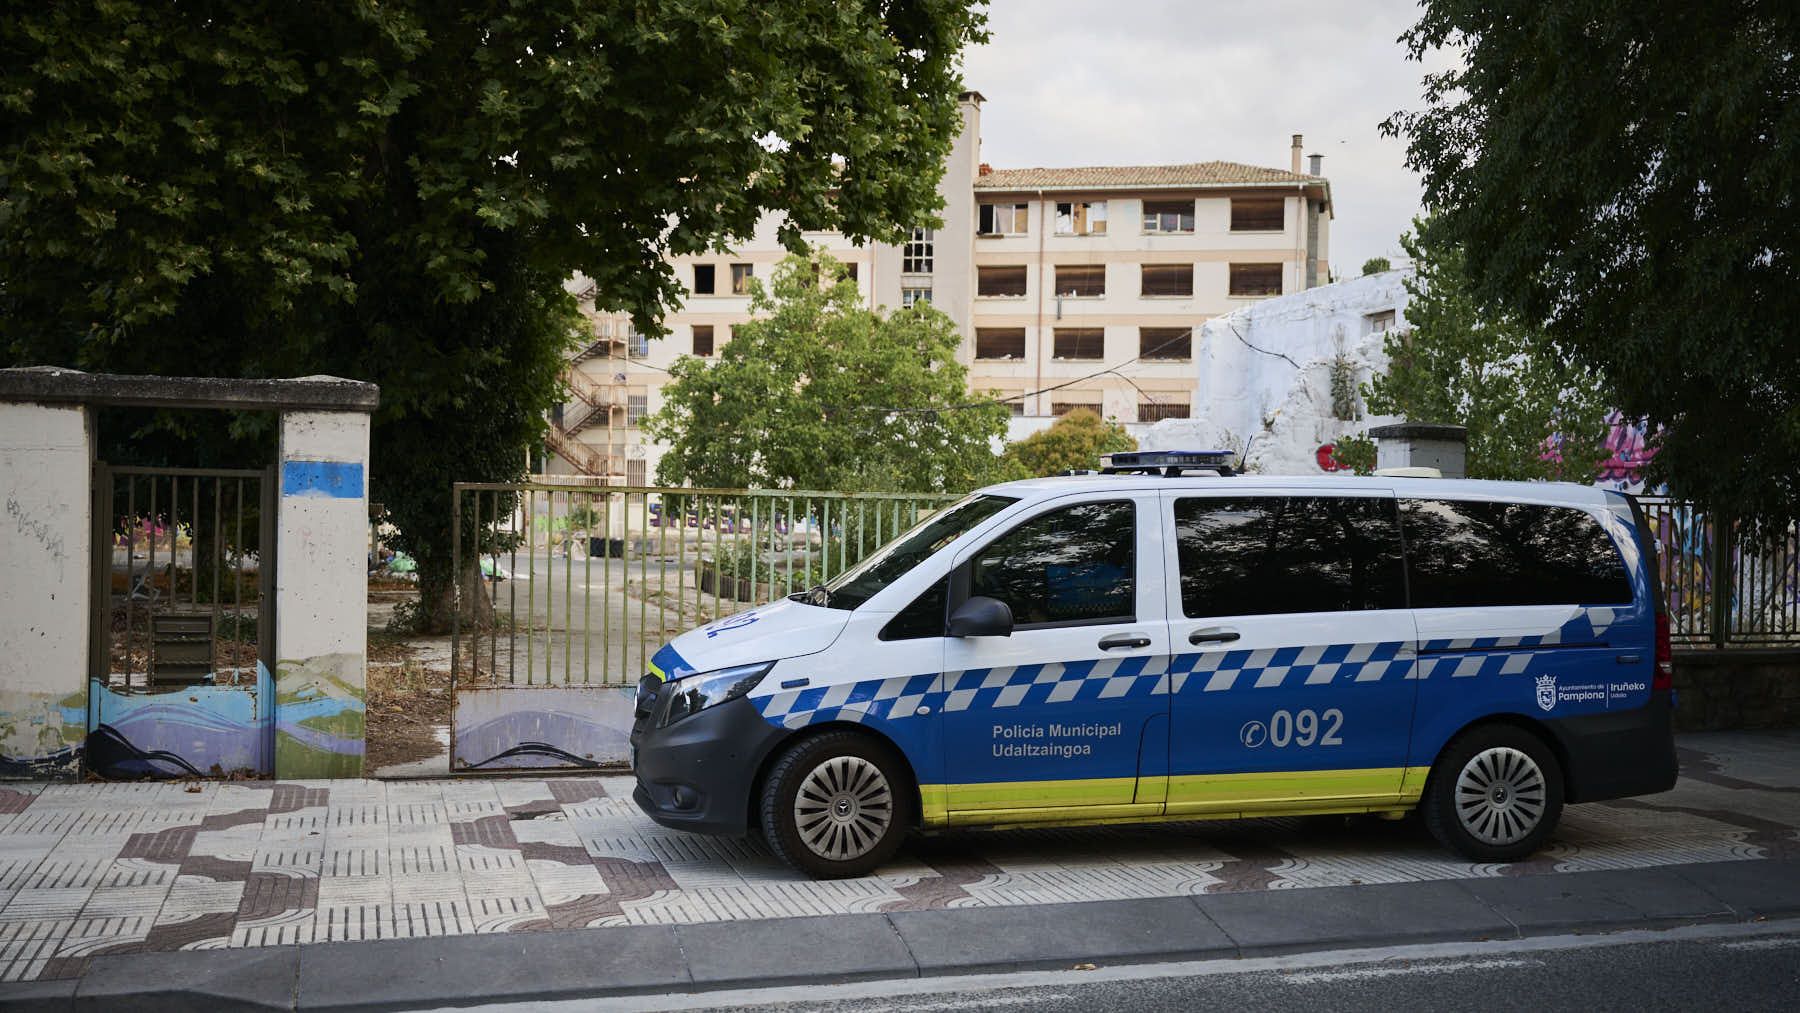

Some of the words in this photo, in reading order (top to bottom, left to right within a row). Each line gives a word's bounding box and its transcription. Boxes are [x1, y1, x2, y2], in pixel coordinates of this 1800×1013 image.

[1610, 682, 1646, 692] Iruñeko
[1558, 691, 1605, 703] Pamplona
[992, 724, 1044, 738] Policía
[1049, 722, 1121, 740] Municipal
[1270, 708, 1344, 748] 092
[992, 743, 1092, 759] Udaltzaingoa
